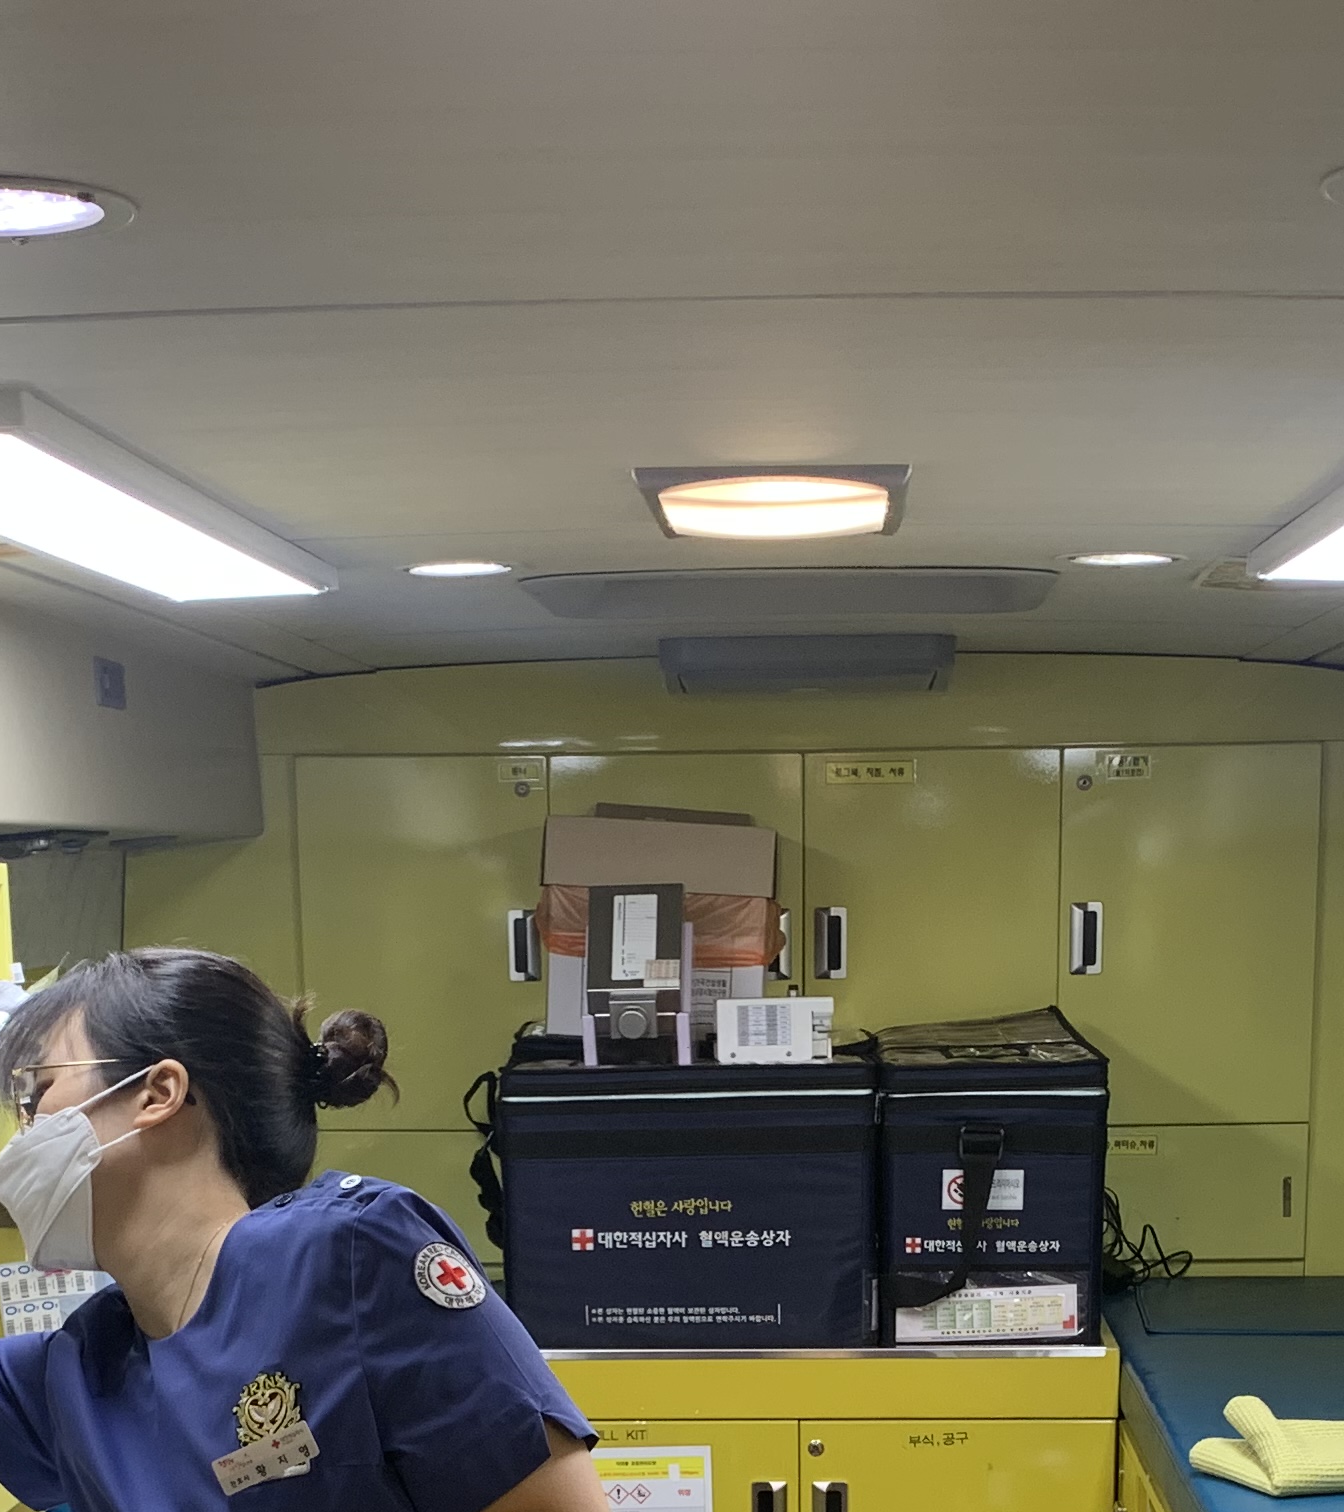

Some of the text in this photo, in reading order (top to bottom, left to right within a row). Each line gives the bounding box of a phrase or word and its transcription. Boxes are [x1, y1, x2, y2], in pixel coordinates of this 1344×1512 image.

[629, 1197, 733, 1217] 헌혈은 사랑입니다
[598, 1230, 792, 1249] 대한적십자사 혈액운송상자
[923, 1239, 1061, 1253] 대한적사 혈액운송상자
[417, 1252, 431, 1290] KOREAN
[427, 1245, 443, 1254] RED
[626, 1429, 647, 1441] KIT
